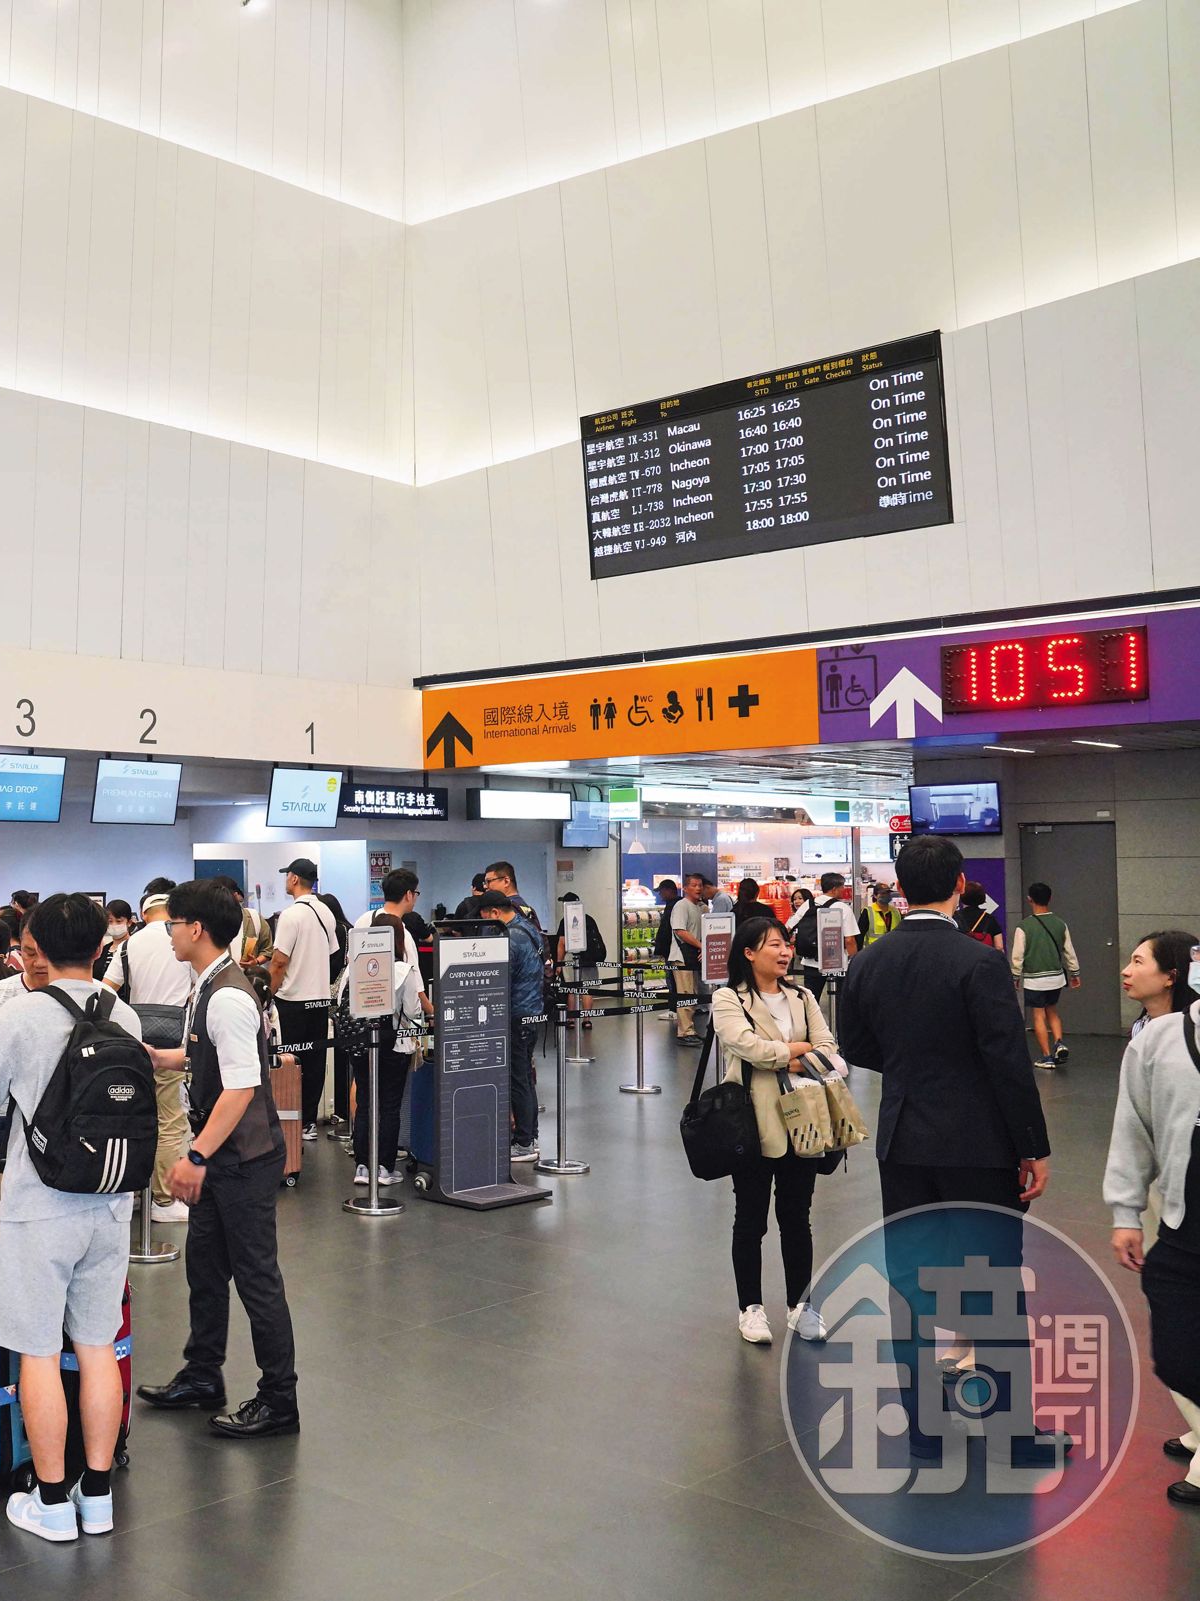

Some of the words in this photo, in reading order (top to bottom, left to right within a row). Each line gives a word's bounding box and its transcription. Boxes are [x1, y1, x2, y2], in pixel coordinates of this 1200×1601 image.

[825, 368, 852, 380] Checkin
[862, 361, 883, 372] Status
[785, 381, 798, 390] ETD
[804, 376, 820, 385] Gate
[869, 378, 889, 391] On
[891, 370, 924, 387] Time
[754, 387, 770, 397] STD
[771, 397, 801, 414] 16:25
[871, 398, 890, 411] On
[893, 390, 926, 406] Time
[737, 406, 766, 421] 16:25
[872, 417, 892, 430] On
[894, 410, 927, 426] Time
[595, 424, 615, 433] Airlines
[621, 418, 637, 427] Flight
[667, 422, 701, 437] Macau
[772, 416, 802, 432] 16:40
[627, 430, 658, 446] JX-331
[739, 424, 768, 439] 16:40
[668, 438, 712, 454] Okinawa
[774, 435, 804, 451] 17:00
[874, 437, 894, 450] On
[896, 430, 929, 445] Time
[629, 447, 660, 463] JX-312
[740, 442, 769, 458] 17:00
[670, 456, 710, 472] Incheon
[775, 454, 805, 470] 17:05
[875, 456, 895, 469] On
[897, 449, 930, 465] Time
[629, 465, 662, 480] TW-670
[741, 461, 770, 476] 17:05
[671, 475, 710, 491] Nagoya
[743, 479, 772, 494] 17:30
[776, 473, 807, 488] 17:30
[877, 476, 897, 489] On
[899, 469, 932, 485] Time
[631, 483, 663, 498] IT-778
[672, 492, 713, 508] Incheon
[744, 498, 773, 513] 17:55
[778, 491, 808, 507] 17:55
[632, 500, 664, 516] LJ-738
[633, 517, 671, 533] KE-2032
[674, 510, 714, 526] Incheon
[745, 516, 775, 531] 18:00
[780, 510, 810, 526] 18:00
[634, 535, 667, 550] VJ-949
[639, 695, 653, 703] WC
[16, 698, 36, 737] 3
[484, 701, 570, 727] 國際線入境
[139, 708, 157, 744] 2
[484, 724, 540, 739] International
[543, 723, 577, 734] Arrivals
[305, 722, 314, 754] 1
[9, 762, 39, 770] STARLUX
[131, 768, 158, 776] STARLUX
[15, 785, 38, 794] DROP
[281, 801, 327, 812] STARLUX
[343, 804, 360, 814] Security
[360, 805, 374, 813] Check
[685, 843, 700, 853] Food
[701, 845, 715, 853] area
[462, 951, 486, 959] STARLUX
[449, 971, 476, 979] CARRY-ON
[476, 969, 500, 978] BAGGAGE
[558, 986, 589, 995] STARLUX
[582, 979, 603, 987] STARLUX
[623, 991, 657, 999] STARLUX
[304, 1000, 332, 1009] STARLUX
[630, 1005, 654, 1014] STARLUX
[676, 998, 698, 1008] STARLUX
[521, 1014, 548, 1025] STARLUX
[579, 1009, 605, 1018] STARLUX
[396, 1028, 428, 1038] STARLUX
[277, 1042, 314, 1054] STARLUX
[109, 1086, 134, 1094] adidas
